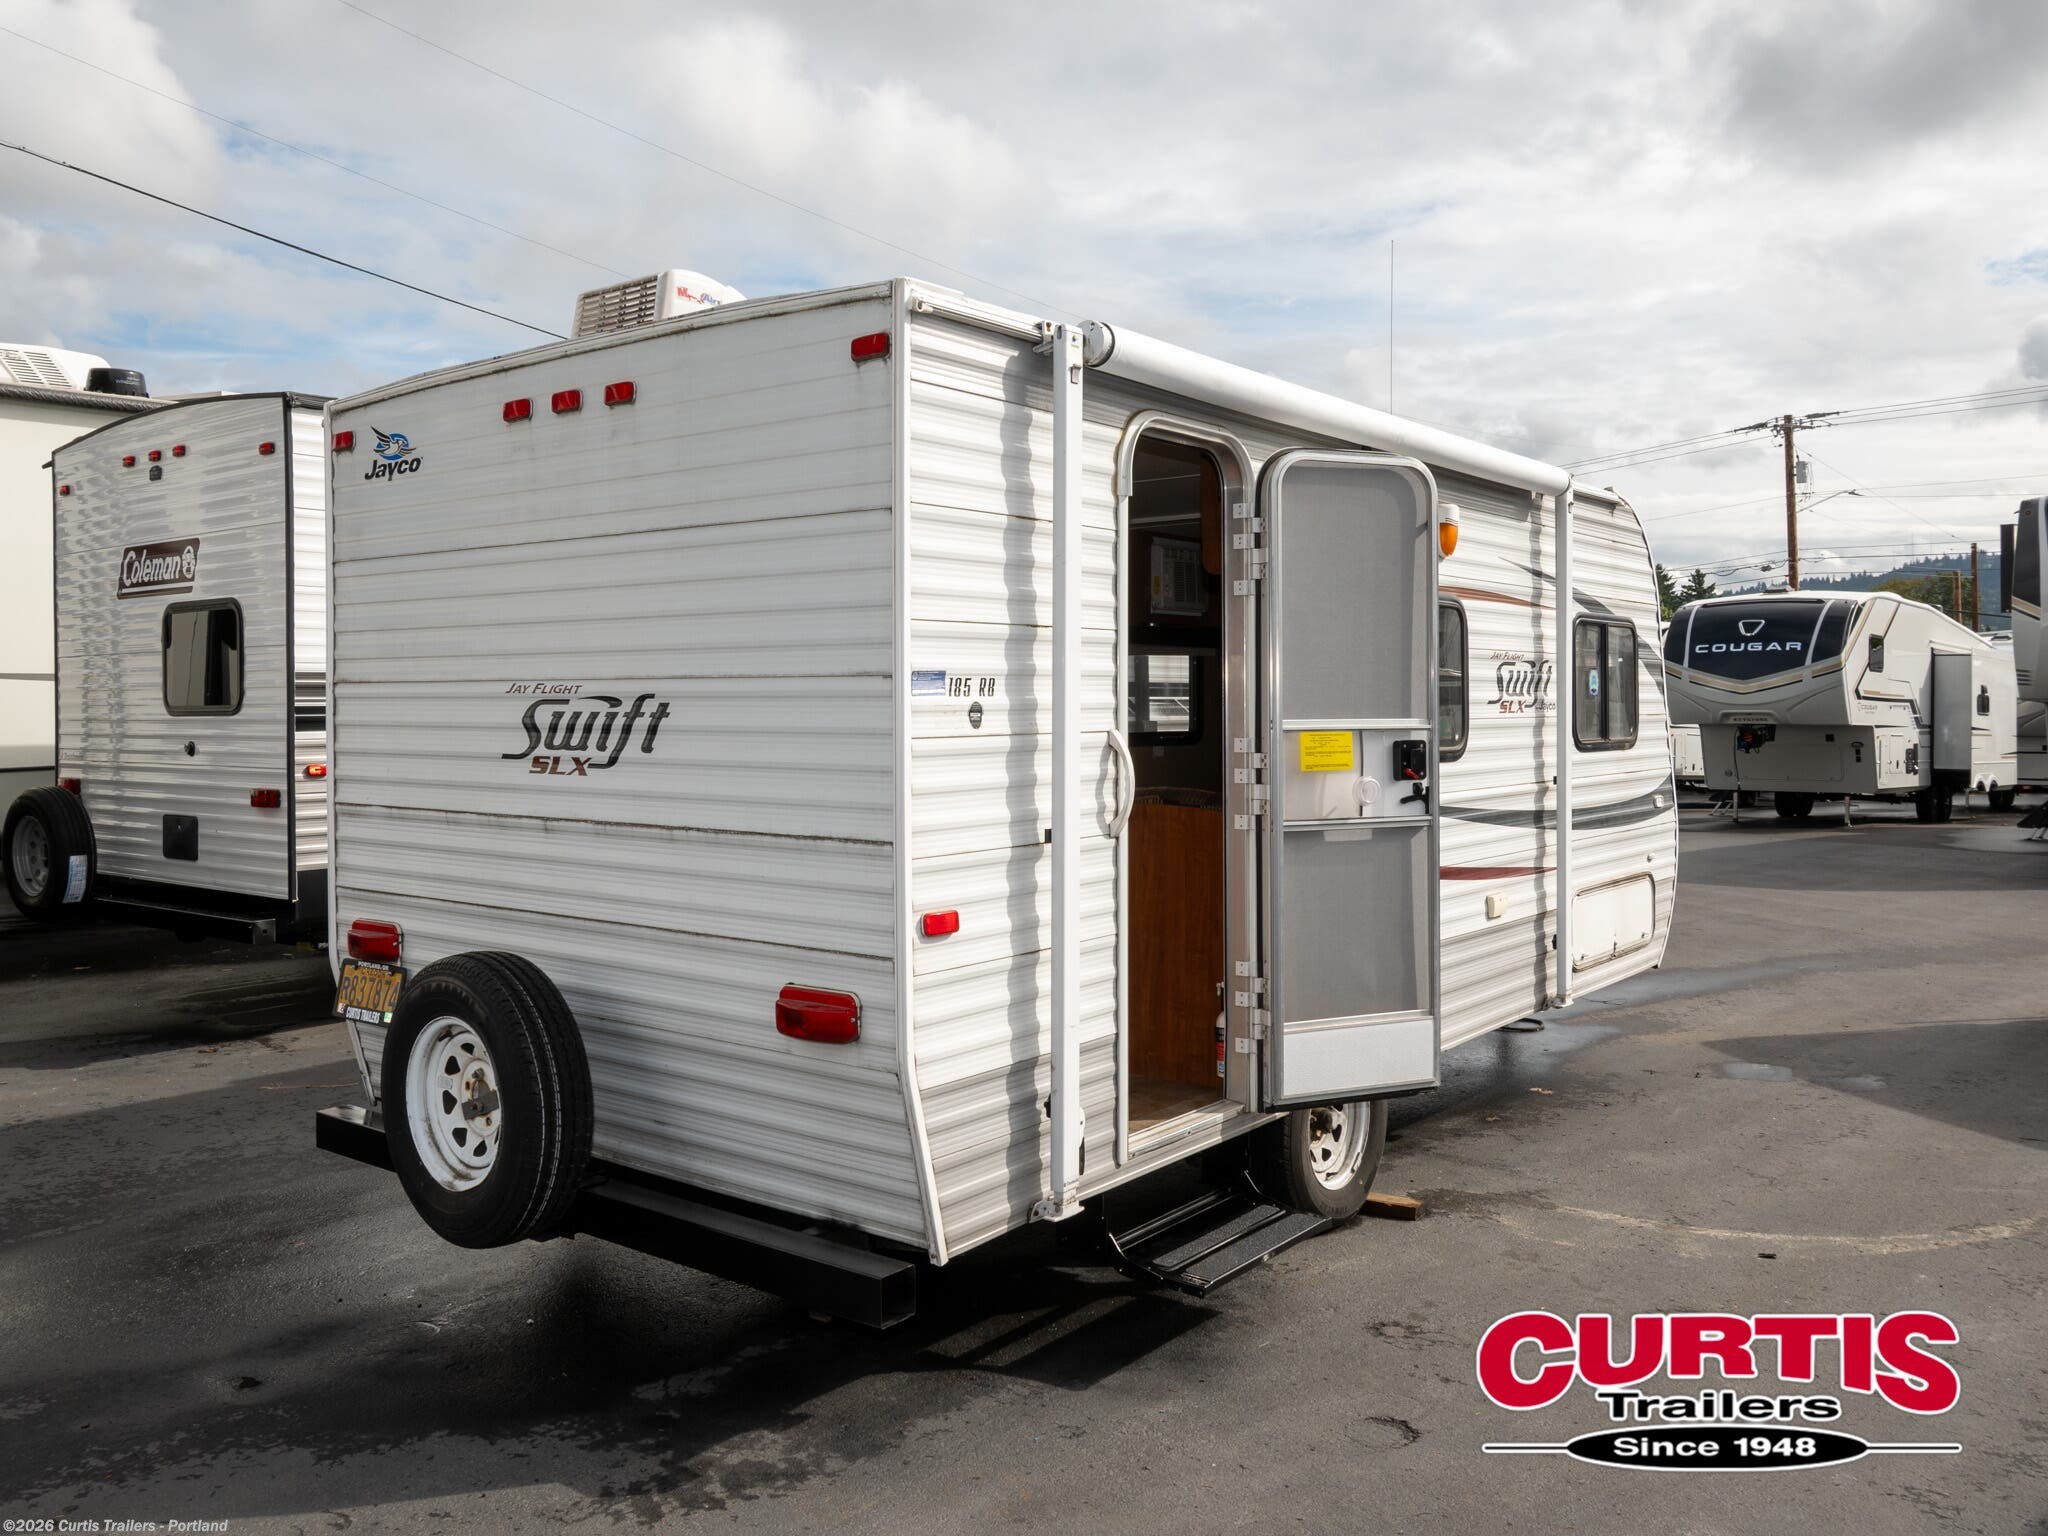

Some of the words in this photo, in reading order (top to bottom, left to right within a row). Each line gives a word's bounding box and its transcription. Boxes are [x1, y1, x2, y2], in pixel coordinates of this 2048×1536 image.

[365, 457, 421, 481] Jayco
[123, 549, 181, 587] Coleman
[1695, 642, 1802, 653] COUGAR
[505, 683, 530, 694] JAY
[532, 683, 583, 695] FLIGHT
[948, 677, 972, 697] 185
[979, 677, 996, 697] RB
[1487, 660, 1552, 708] Swift
[1499, 700, 1526, 713] SLX
[501, 693, 671, 769] Swift
[529, 755, 592, 776] SLX
[340, 974, 401, 1009] R837874
